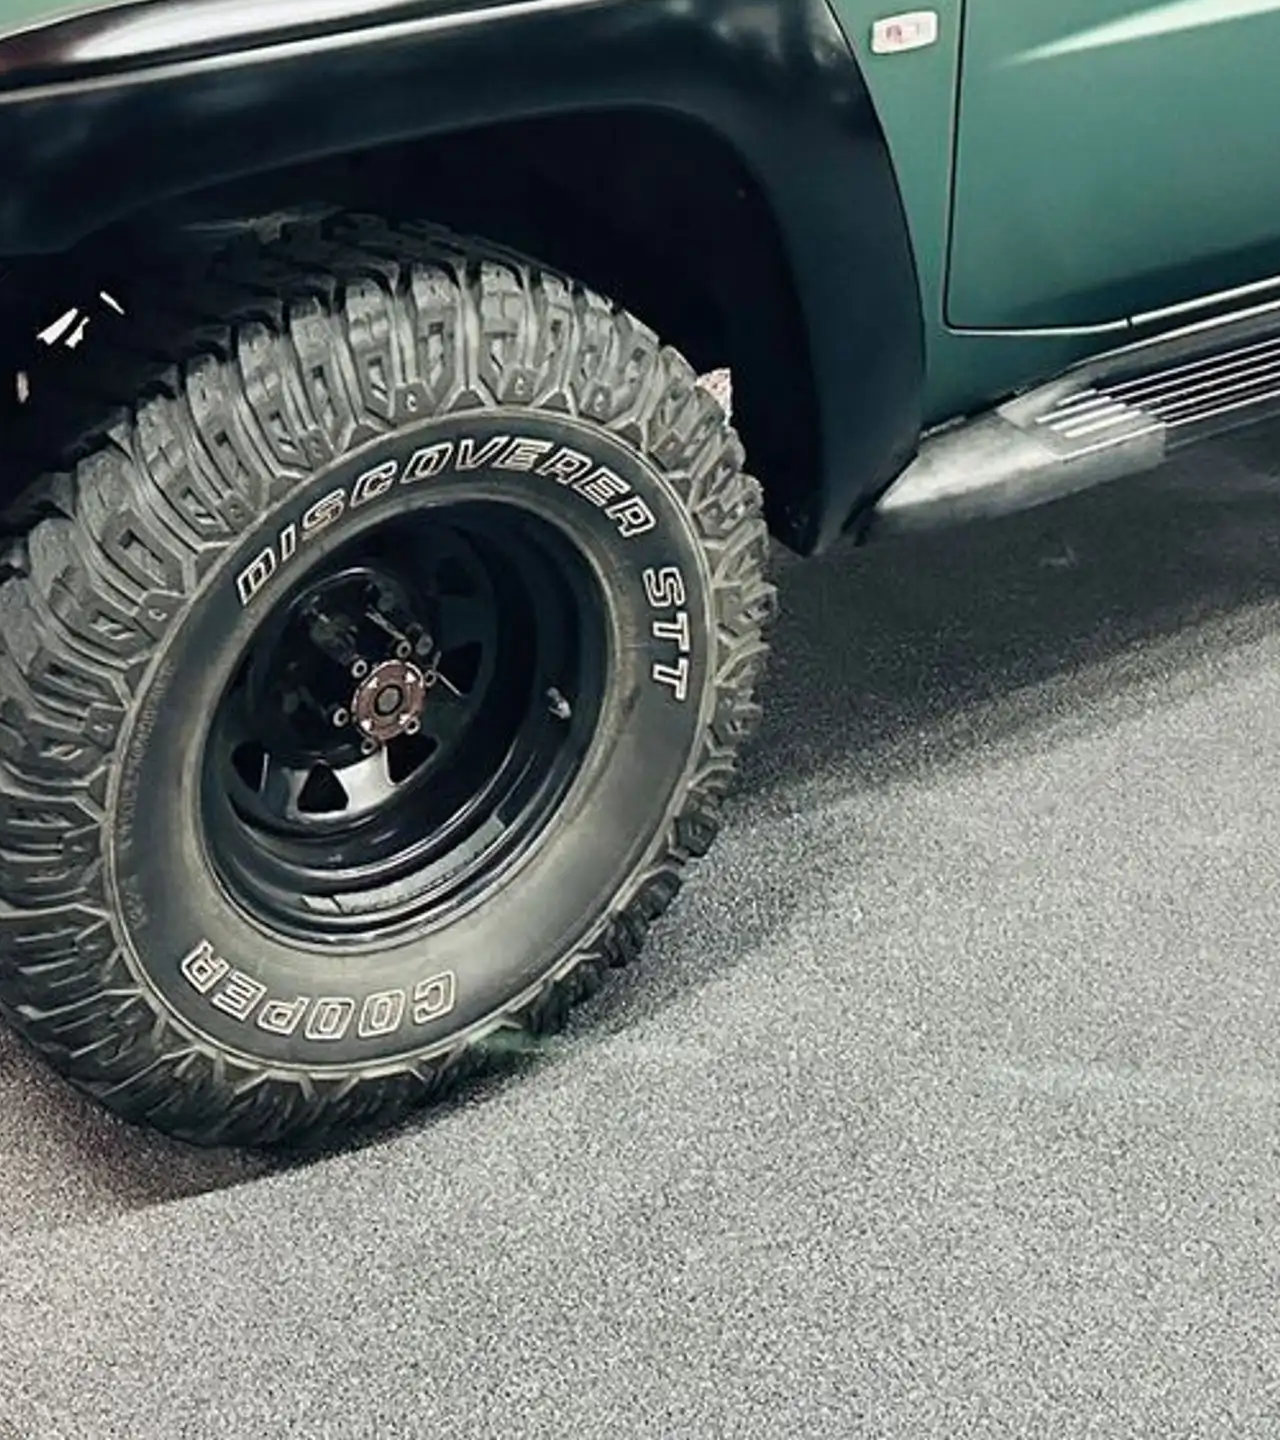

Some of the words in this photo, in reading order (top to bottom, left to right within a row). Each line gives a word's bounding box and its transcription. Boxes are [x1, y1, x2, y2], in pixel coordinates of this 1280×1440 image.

[234, 435, 658, 607] DISCOVERER
[642, 566, 690, 703] STT
[180, 938, 456, 1040] COOPER
